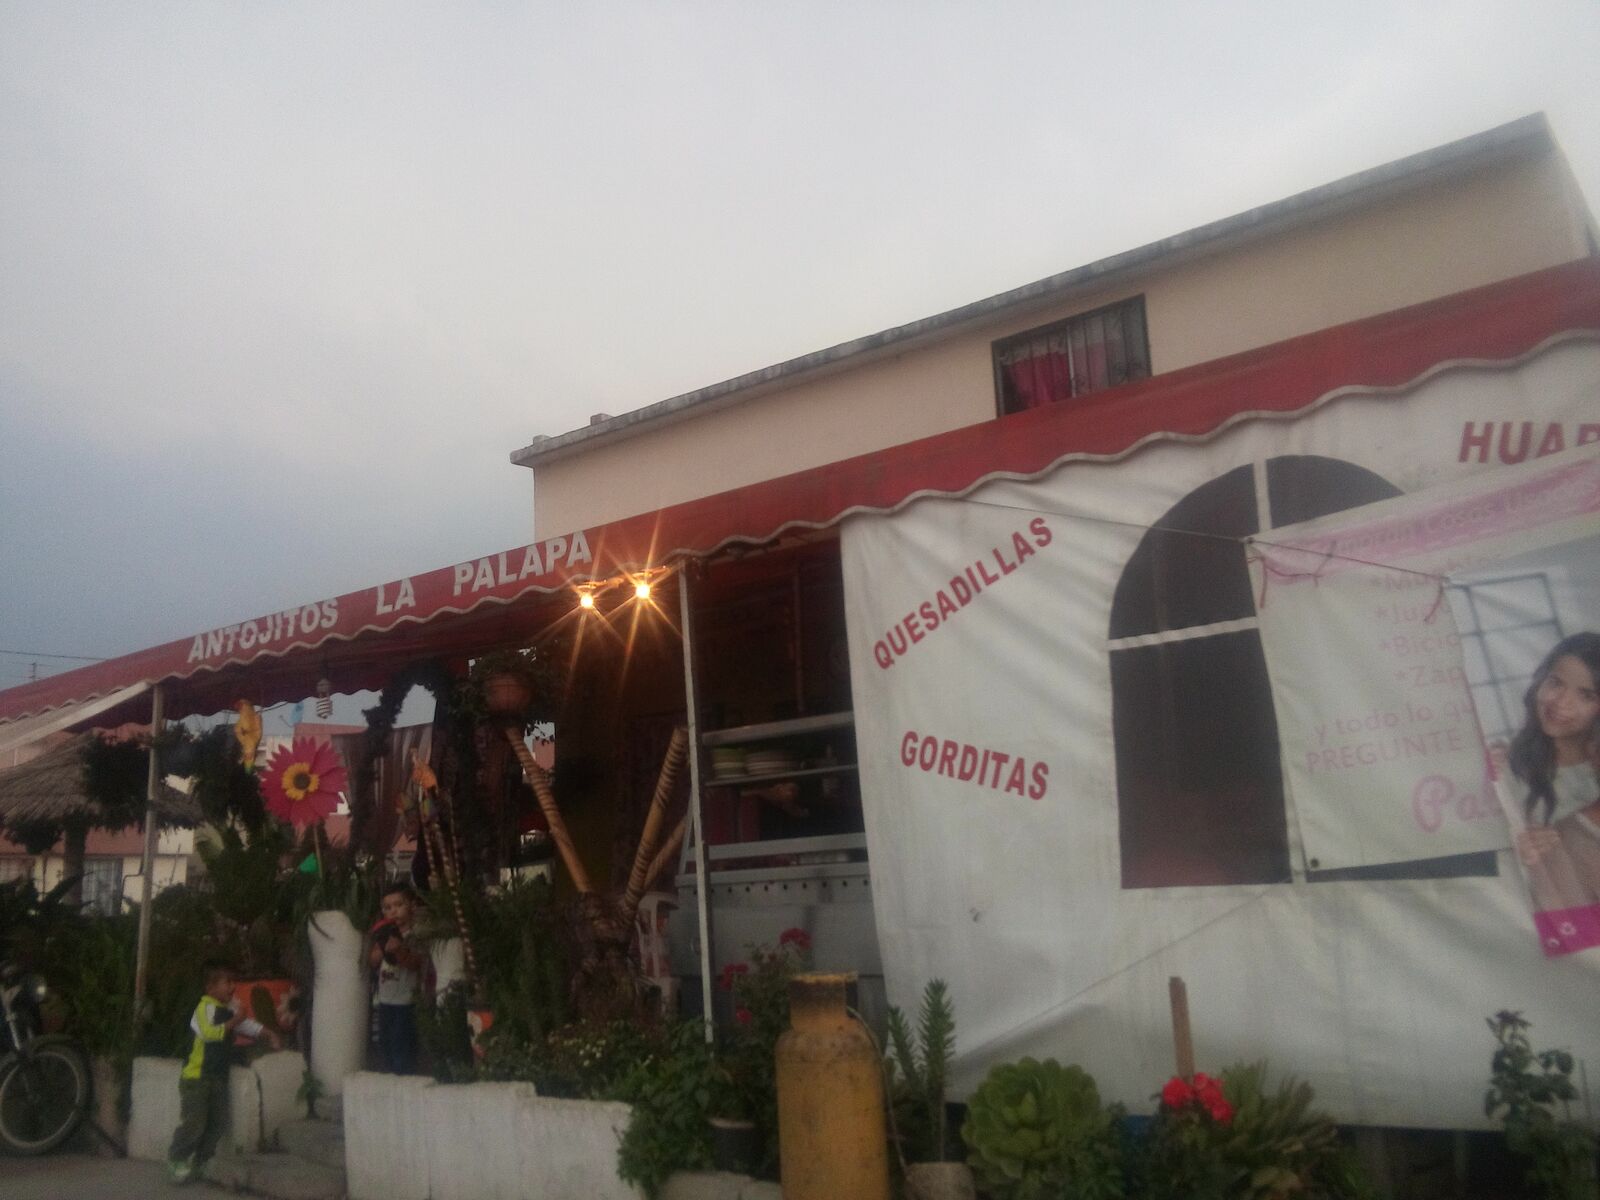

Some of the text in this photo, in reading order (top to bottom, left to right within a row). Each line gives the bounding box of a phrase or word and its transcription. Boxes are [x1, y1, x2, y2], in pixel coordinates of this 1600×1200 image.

[187, 530, 592, 664] ANTOJITOS LA PALAPA
[873, 517, 1053, 670] QUESADILLAS
[1305, 728, 1463, 776] PREGUNTE
[1335, 708, 1399, 735] todo
[1406, 701, 1433, 723] lo
[900, 730, 1050, 801] GORDITAS
